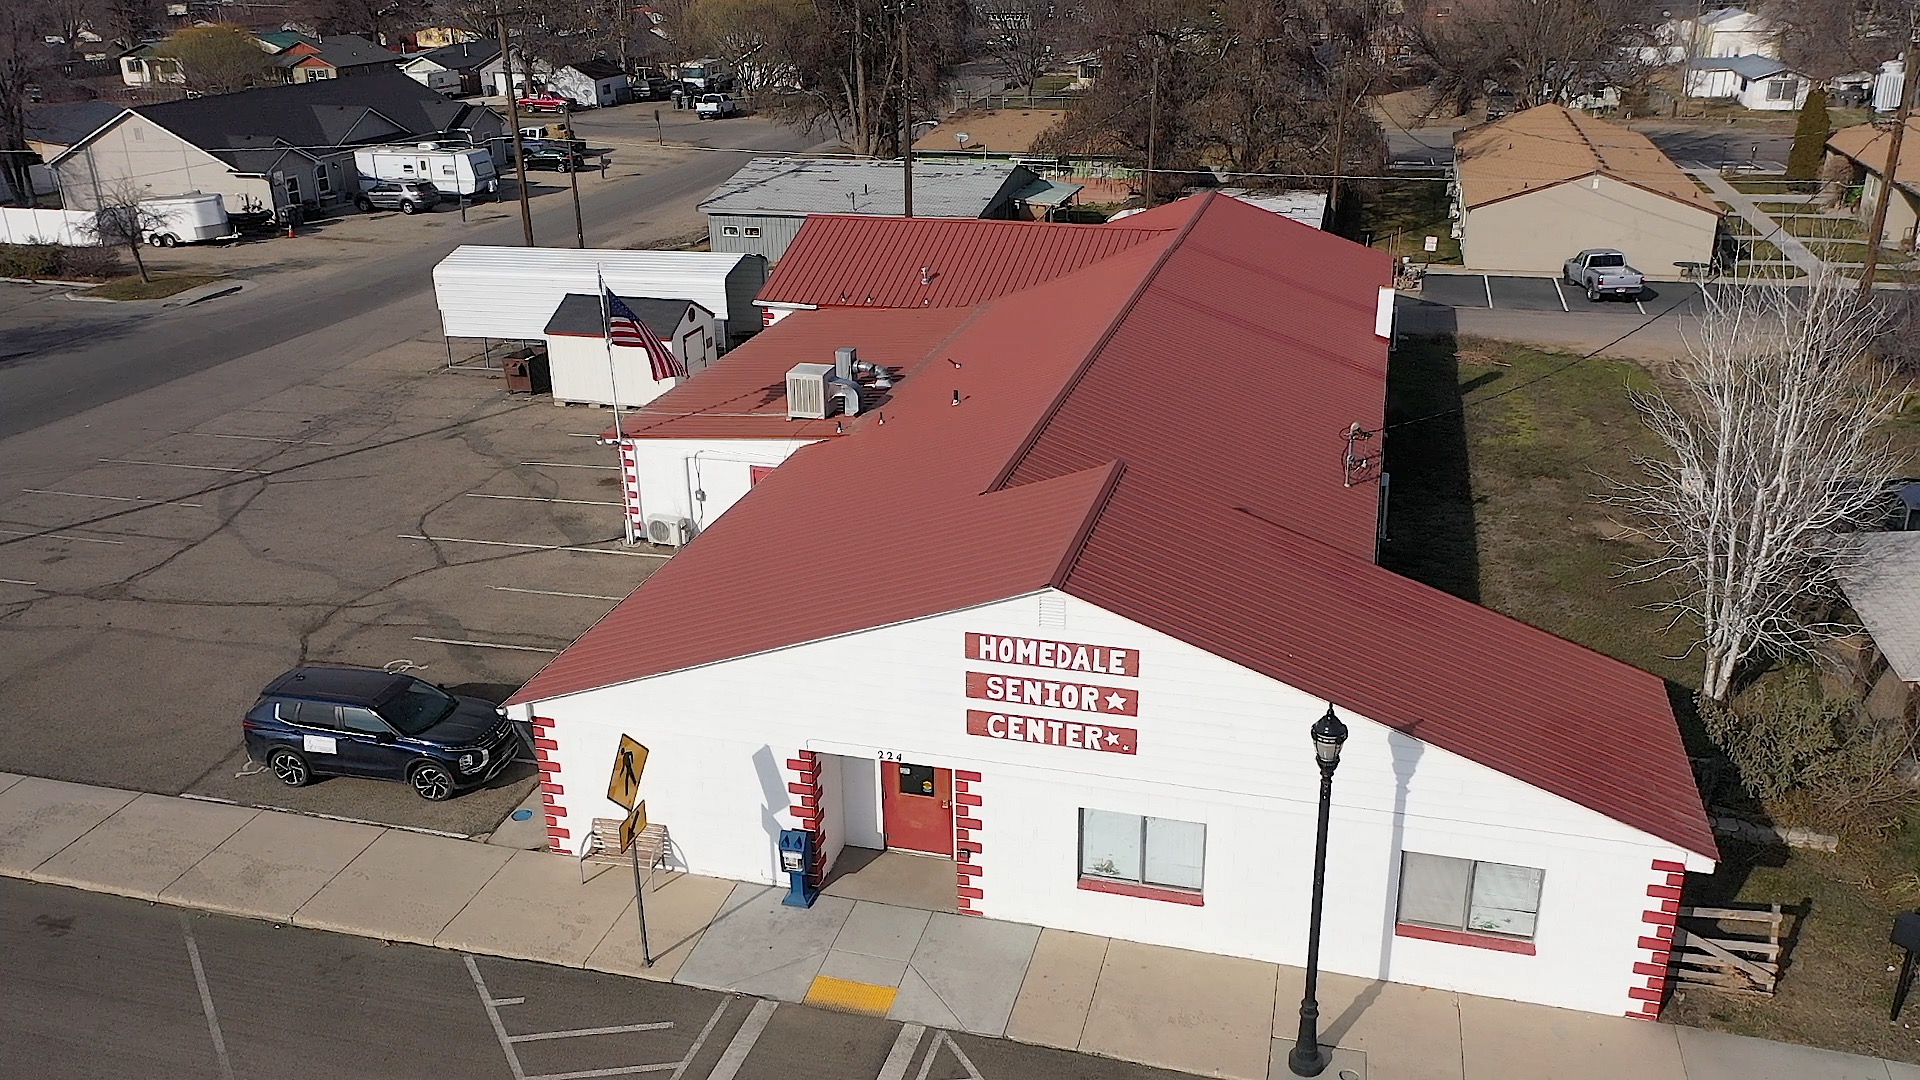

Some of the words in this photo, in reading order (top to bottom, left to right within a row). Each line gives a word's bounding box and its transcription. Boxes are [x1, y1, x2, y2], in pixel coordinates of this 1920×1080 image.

[979, 635, 1127, 675] HOMEDALE
[986, 676, 1100, 712] SENIOR
[987, 713, 1103, 751] CENTER
[877, 750, 902, 762] 224
